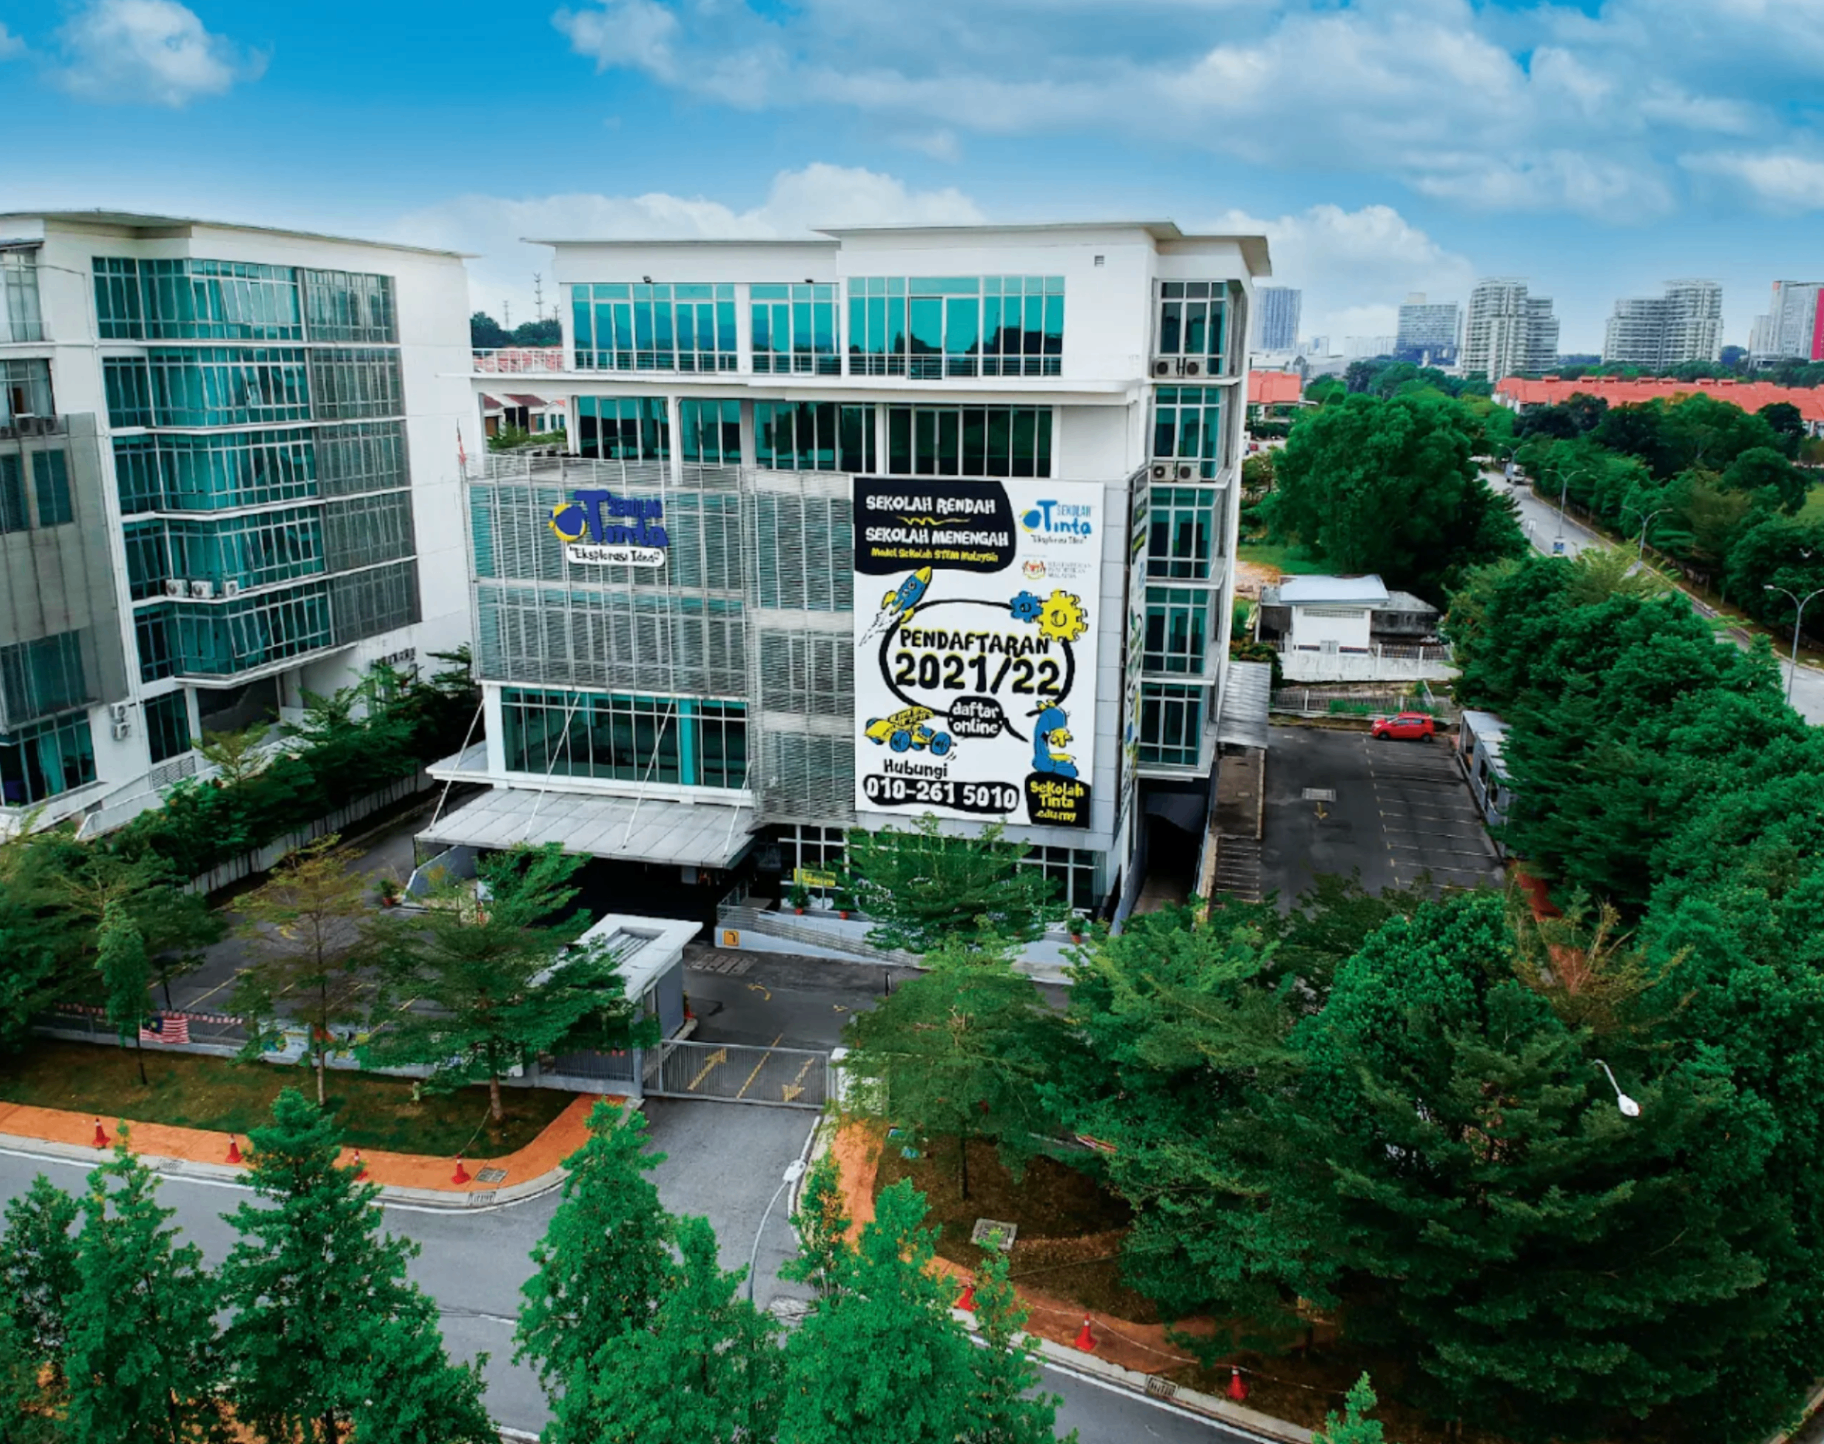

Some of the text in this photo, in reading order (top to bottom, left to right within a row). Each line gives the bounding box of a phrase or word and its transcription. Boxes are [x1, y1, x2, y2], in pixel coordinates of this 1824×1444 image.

[866, 495, 996, 514] SEKOLAH RENDAH
[865, 527, 1009, 547] SEKOLAH MENENGAH
[900, 628, 1050, 658] PENDAFTARAN
[895, 651, 1060, 695] 2021/22
[952, 701, 999, 718] daftar
[883, 758, 948, 780] Hubungi
[866, 777, 1017, 810] 010-261 5010
[1038, 792, 1075, 808] Tinta
